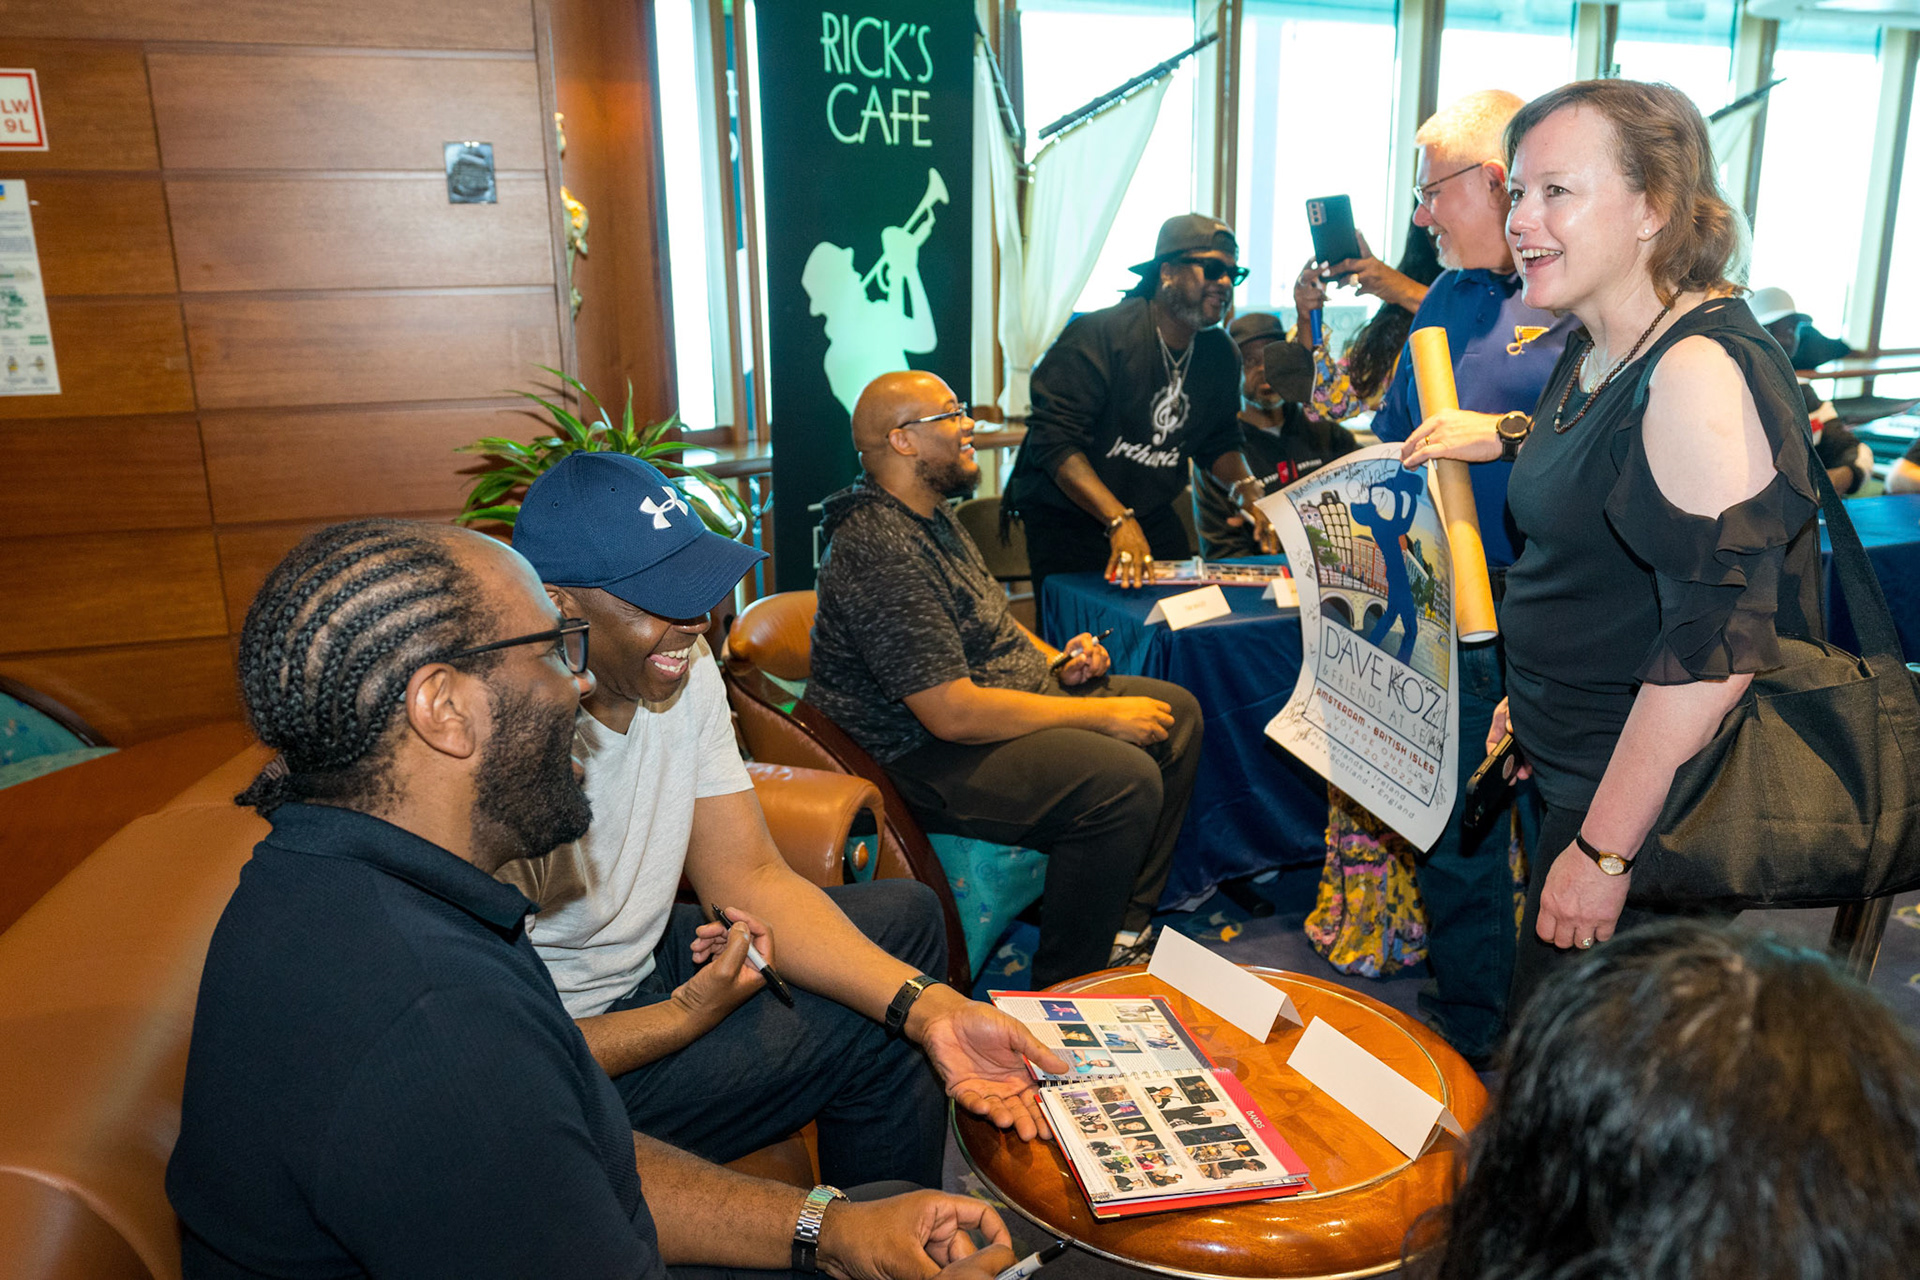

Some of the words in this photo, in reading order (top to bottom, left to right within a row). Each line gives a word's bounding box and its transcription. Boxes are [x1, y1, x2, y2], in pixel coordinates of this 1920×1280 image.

[820, 11, 934, 83] RICK'S
[4, 117, 32, 134] 9L
[826, 82, 933, 148] CAFE
[1325, 625, 1383, 692] DAVE
[1387, 665, 1441, 730] KOZ
[1331, 668, 1382, 714] FRIENDS
[1388, 710, 1404, 729] AT
[1316, 687, 1366, 726] AMSTERDAM
[1373, 726, 1408, 756] BRITISH
[1409, 751, 1435, 775] ISLES
[1334, 713, 1375, 747] VOYAGE
[1381, 747, 1403, 767] ONE
[1312, 730, 1363, 770] Netherlands
[1373, 774, 1407, 801] Ireland
[1330, 753, 1368, 785] Scotland
[1377, 788, 1415, 819] England
[1383, 761, 1413, 786] 2022
